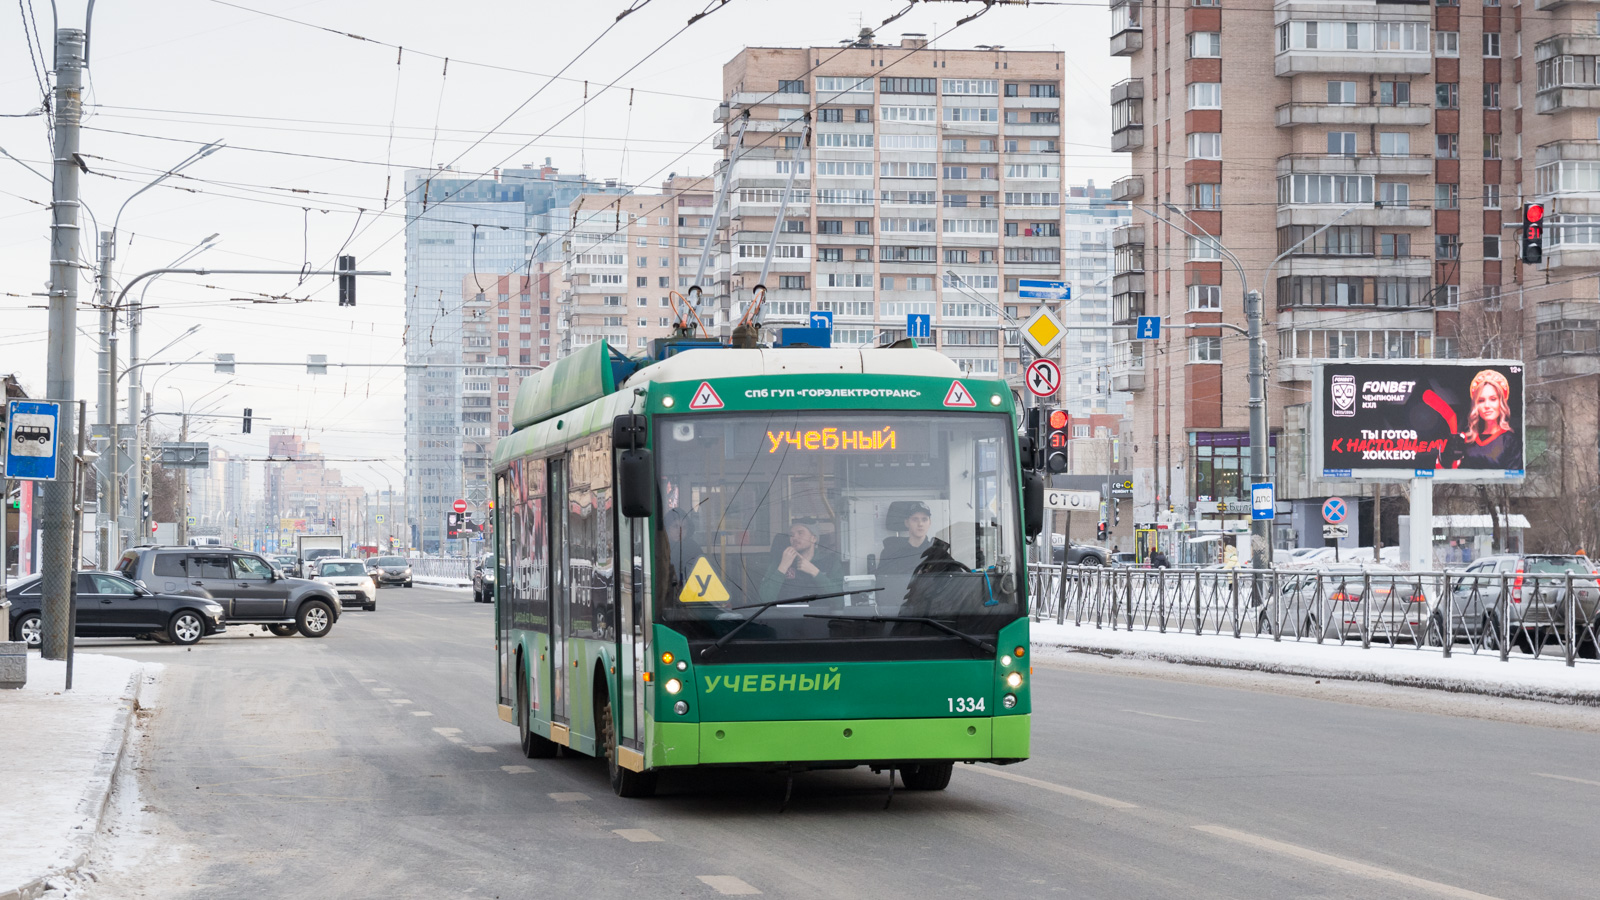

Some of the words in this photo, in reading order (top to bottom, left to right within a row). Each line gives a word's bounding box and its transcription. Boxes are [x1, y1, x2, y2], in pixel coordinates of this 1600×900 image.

[1527, 227, 1540, 240] 31
[1510, 366, 1522, 374] 12+
[744, 389, 768, 398] СПб
[771, 389, 795, 398] ГУП
[796, 388, 921, 398] «ГОРЭЛЕКТРОТРАНС»
[1362, 381, 1416, 393] FONBET
[767, 426, 896, 453] учебный
[1052, 434, 1065, 447] 31
[1361, 430, 1379, 440] ТЫ
[1381, 430, 1418, 440] ГОТОВ
[1331, 438, 1344, 454] К
[1346, 438, 1448, 453] НАСТОЯЩЕМУ
[1362, 450, 1416, 460] ХОККЕЮ?
[1049, 493, 1093, 508] СТОП
[694, 574, 711, 597] У
[704, 667, 841, 693] УЧЕБНЫЙ
[947, 697, 985, 712] 1334
